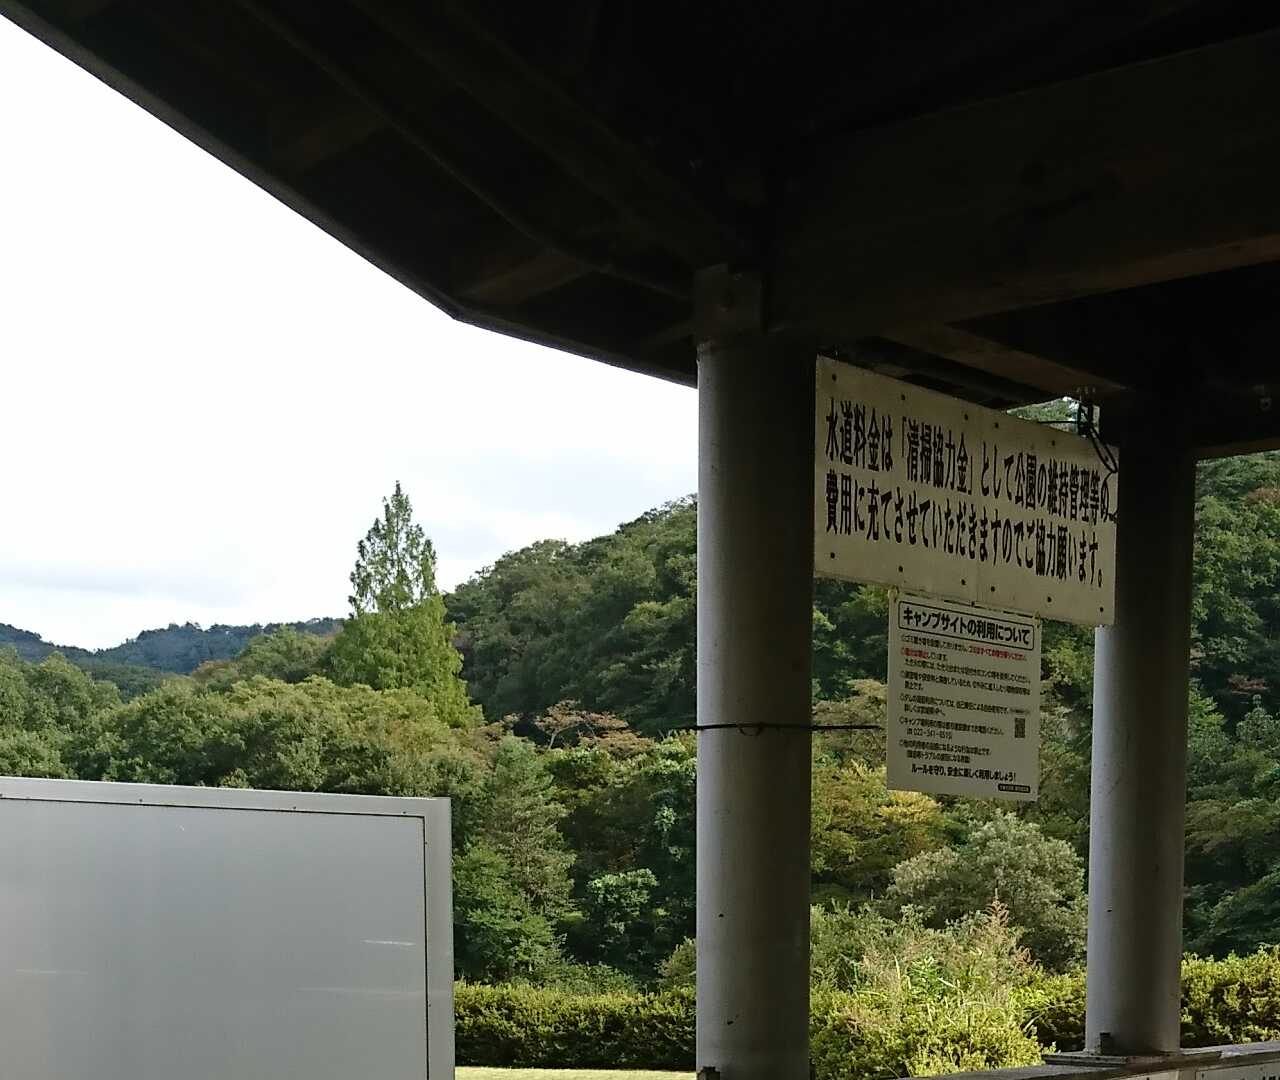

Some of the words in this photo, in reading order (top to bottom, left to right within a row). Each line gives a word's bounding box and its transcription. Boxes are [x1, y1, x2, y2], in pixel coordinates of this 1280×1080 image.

[825, 470, 1104, 588] 費用に充てさせていただきますのでご協力願います。
[903, 606, 1031, 645] キャンプサイトの利用について
